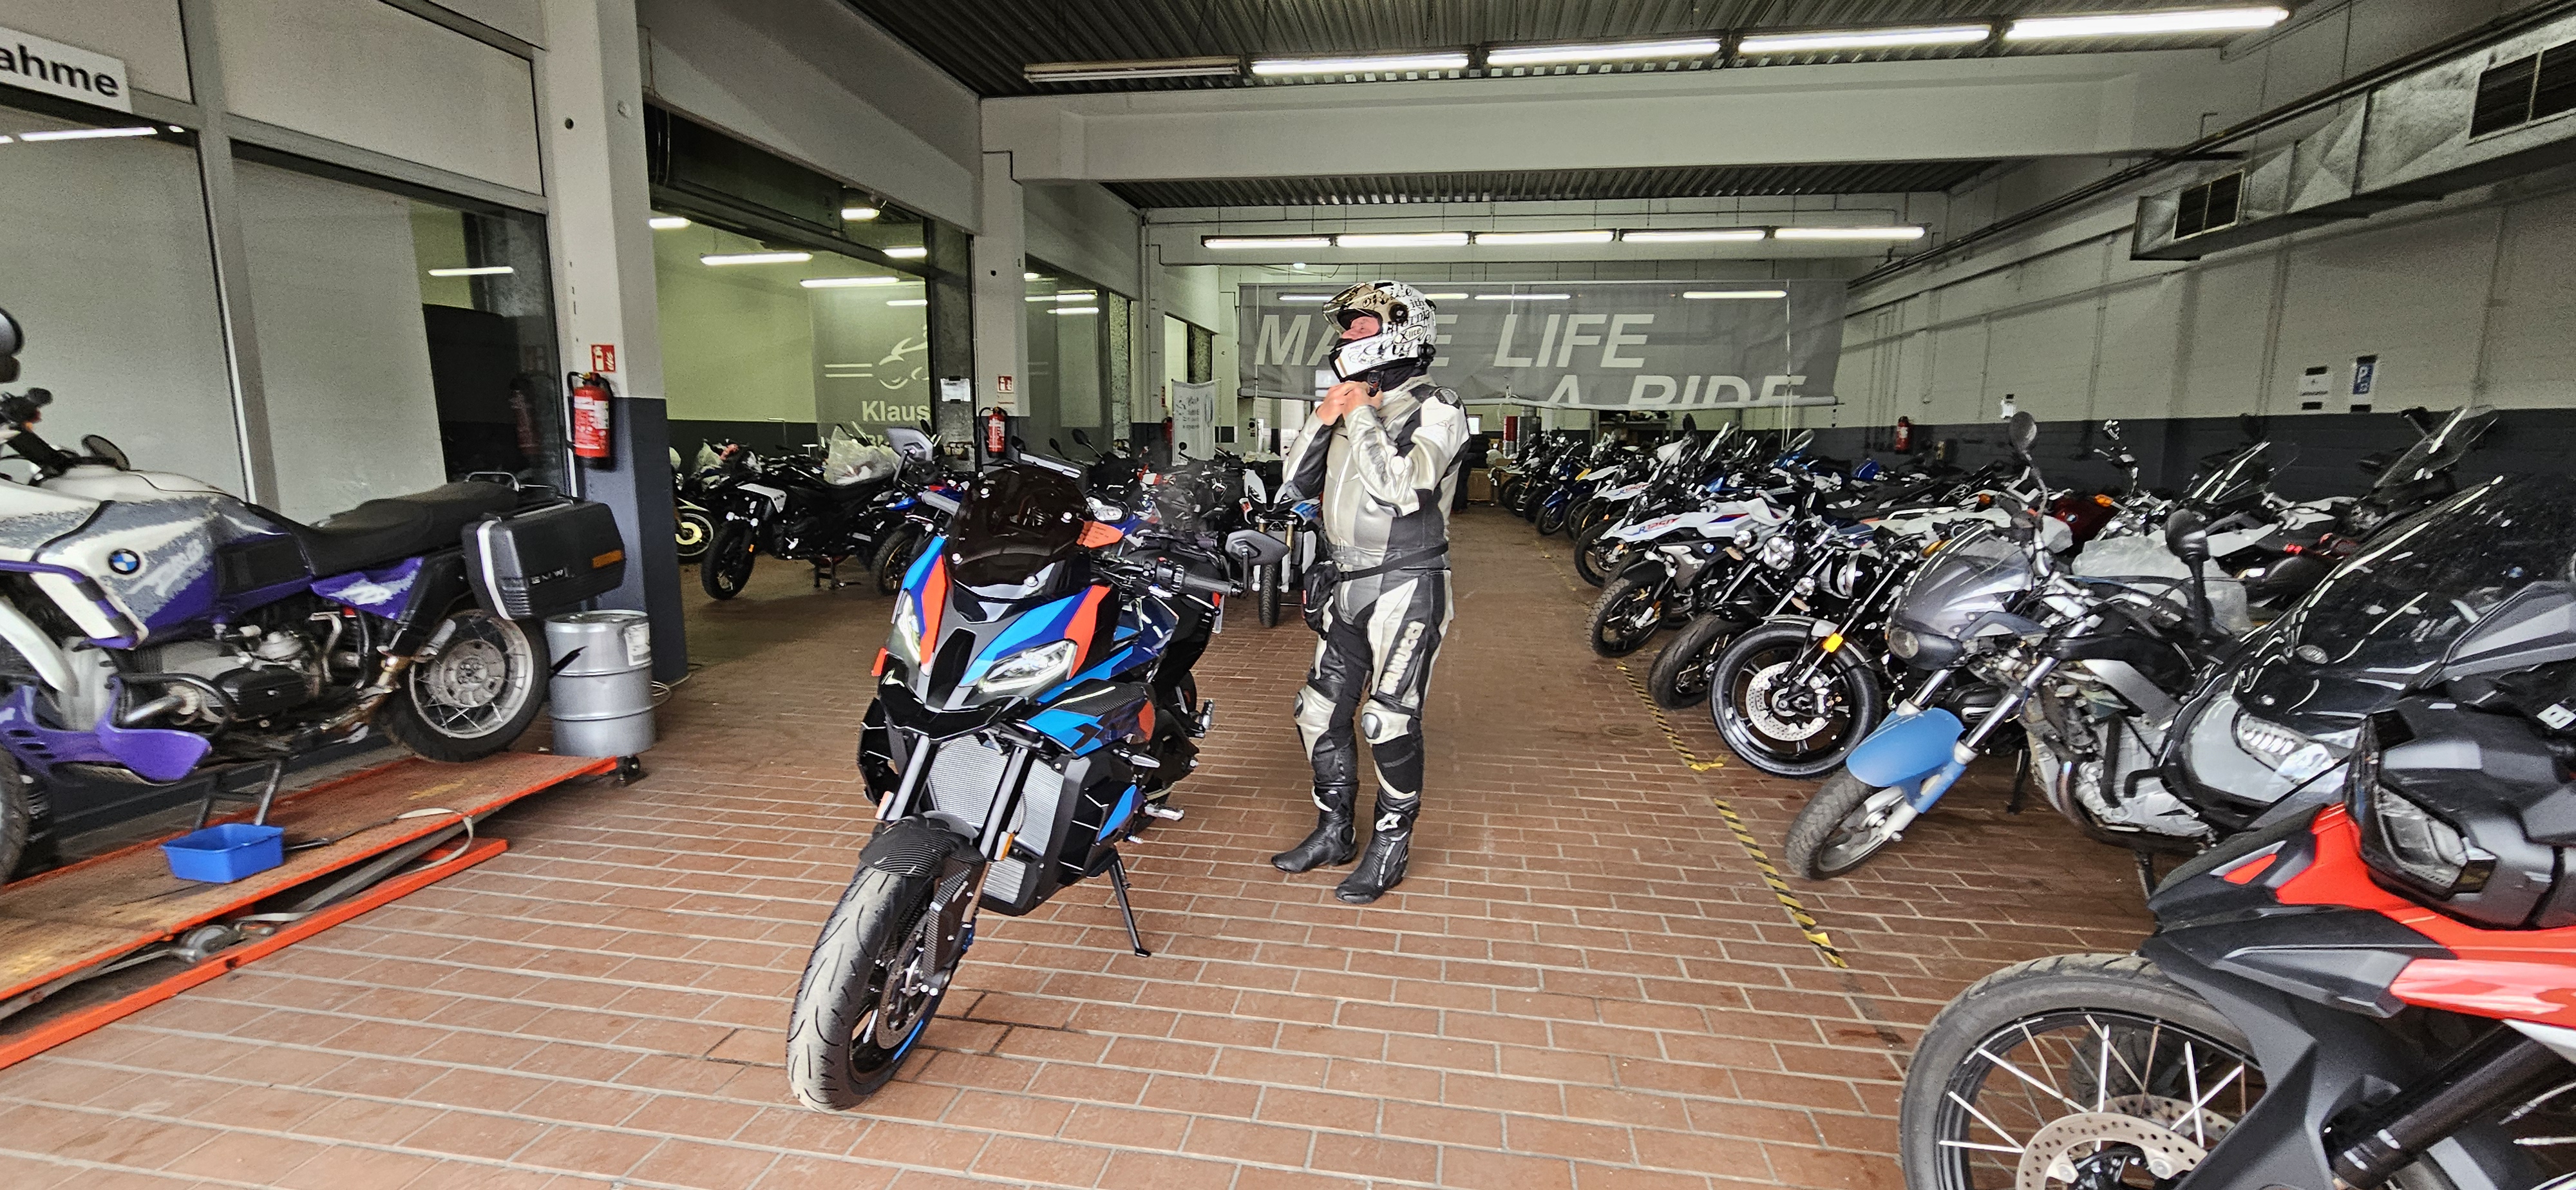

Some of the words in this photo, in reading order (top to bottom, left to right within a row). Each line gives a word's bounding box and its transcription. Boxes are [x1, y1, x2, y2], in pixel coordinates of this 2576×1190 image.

[1255, 314, 1458, 366] MAE
[1493, 314, 1654, 368] LIFE
[862, 401, 931, 422] Klaus
